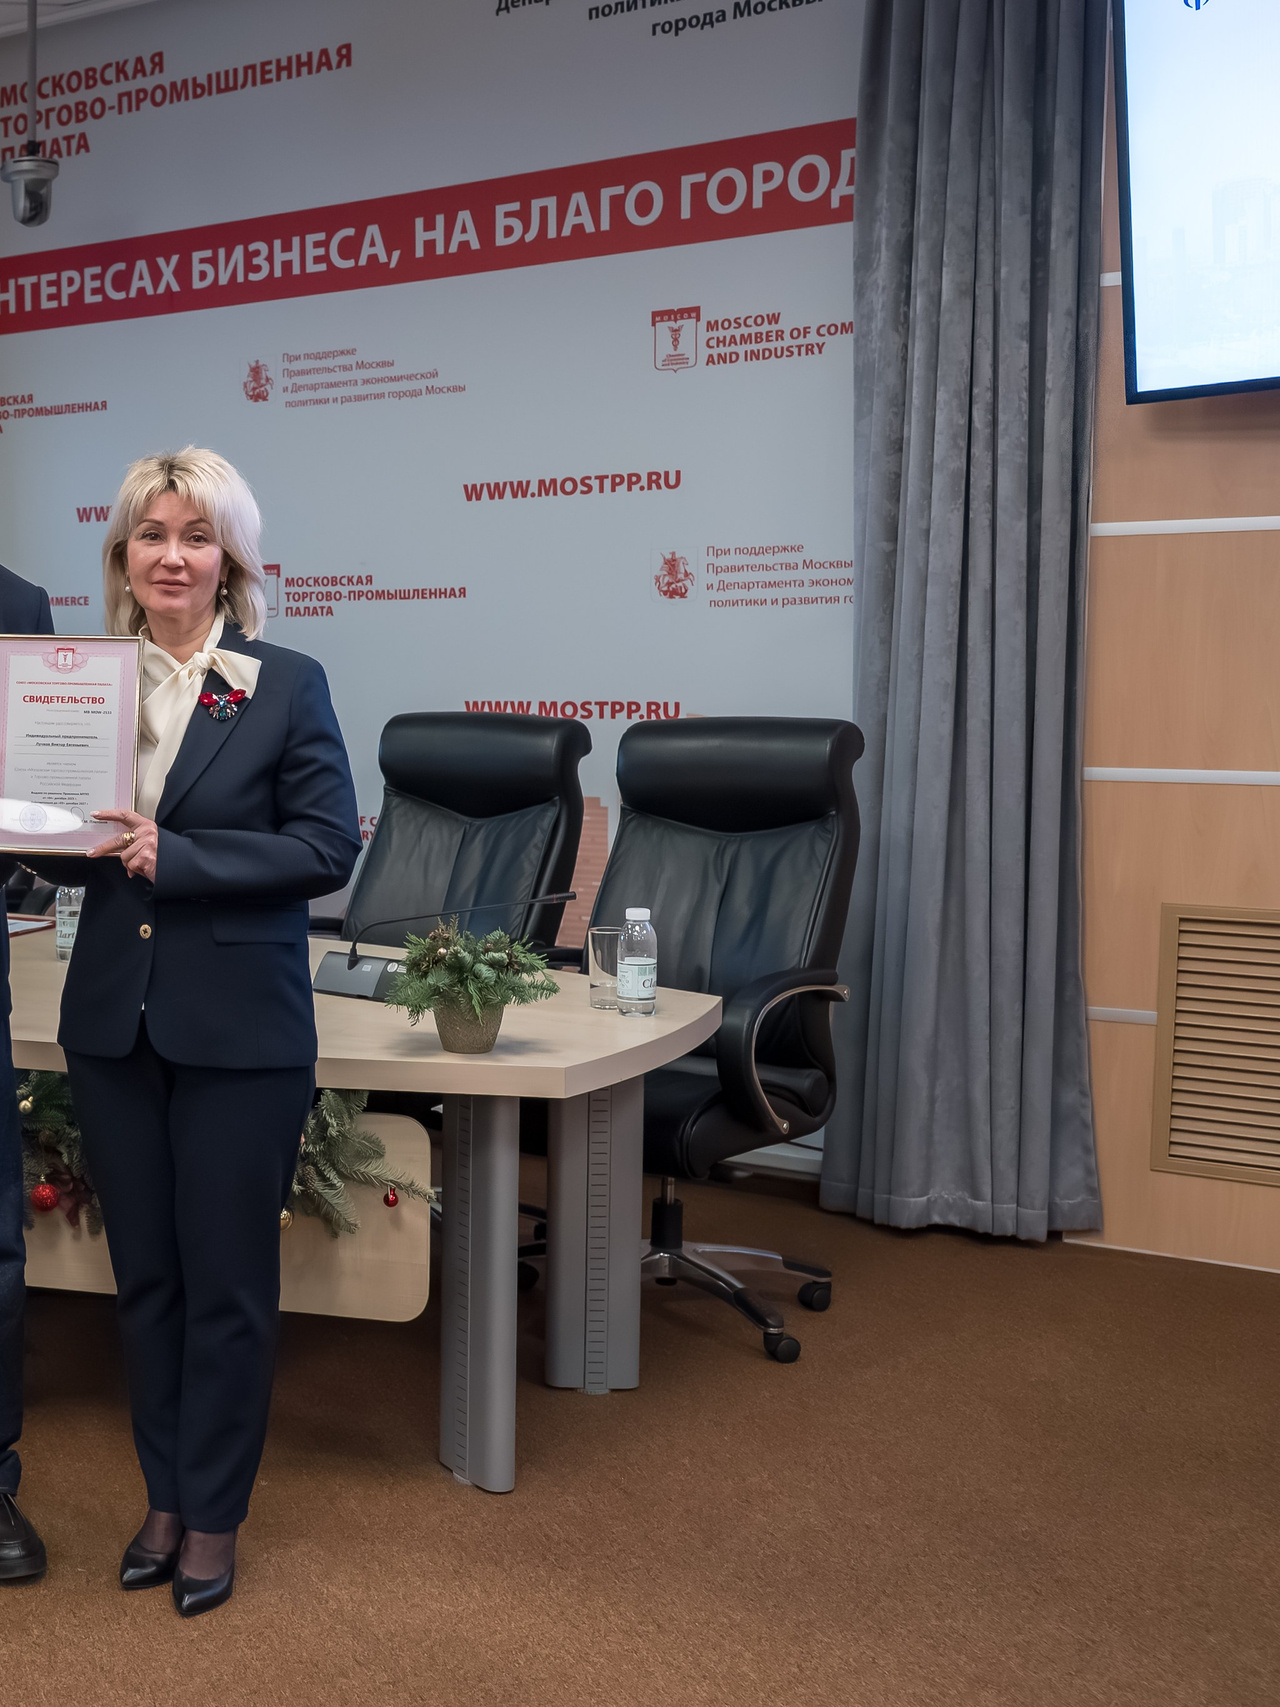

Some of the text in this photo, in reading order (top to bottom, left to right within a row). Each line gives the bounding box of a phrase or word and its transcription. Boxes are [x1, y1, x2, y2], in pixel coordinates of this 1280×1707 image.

[588, 0, 682, 20] полити
[651, 8, 727, 37] города
[191, 223, 401, 290] БИЗНЕСА,
[414, 209, 481, 258] НА
[494, 180, 664, 247] БЛАГО
[706, 312, 781, 332] MOSCOW
[706, 329, 785, 349] CHAMBER
[789, 326, 811, 340] OF
[282, 347, 357, 363] При поддержке
[705, 342, 826, 366] AND INDUSTRY
[282, 358, 395, 378] Правительства Москвы
[282, 368, 439, 394] и Департамента экономической
[285, 383, 466, 408] политики и развития города Москвы
[463, 470, 681, 502] WWW.MOSTPP.RU
[76, 505, 112, 523] WW
[706, 543, 804, 558] При поддержке
[706, 558, 853, 574] Правительства Москвы
[285, 575, 373, 588] МОСКОВСКАЯ
[706, 581, 714, 591] и
[716, 579, 805, 592] Департамента
[285, 587, 467, 603] ТОРГОВО-ПРОМЫШЛЕННАЯ
[709, 597, 767, 608] политики
[770, 597, 778, 606] и
[781, 595, 840, 608] развития
[285, 606, 334, 617] ПАЛАТА
[22, 695, 106, 705] СВИДЕТЕЛЬСТВО
